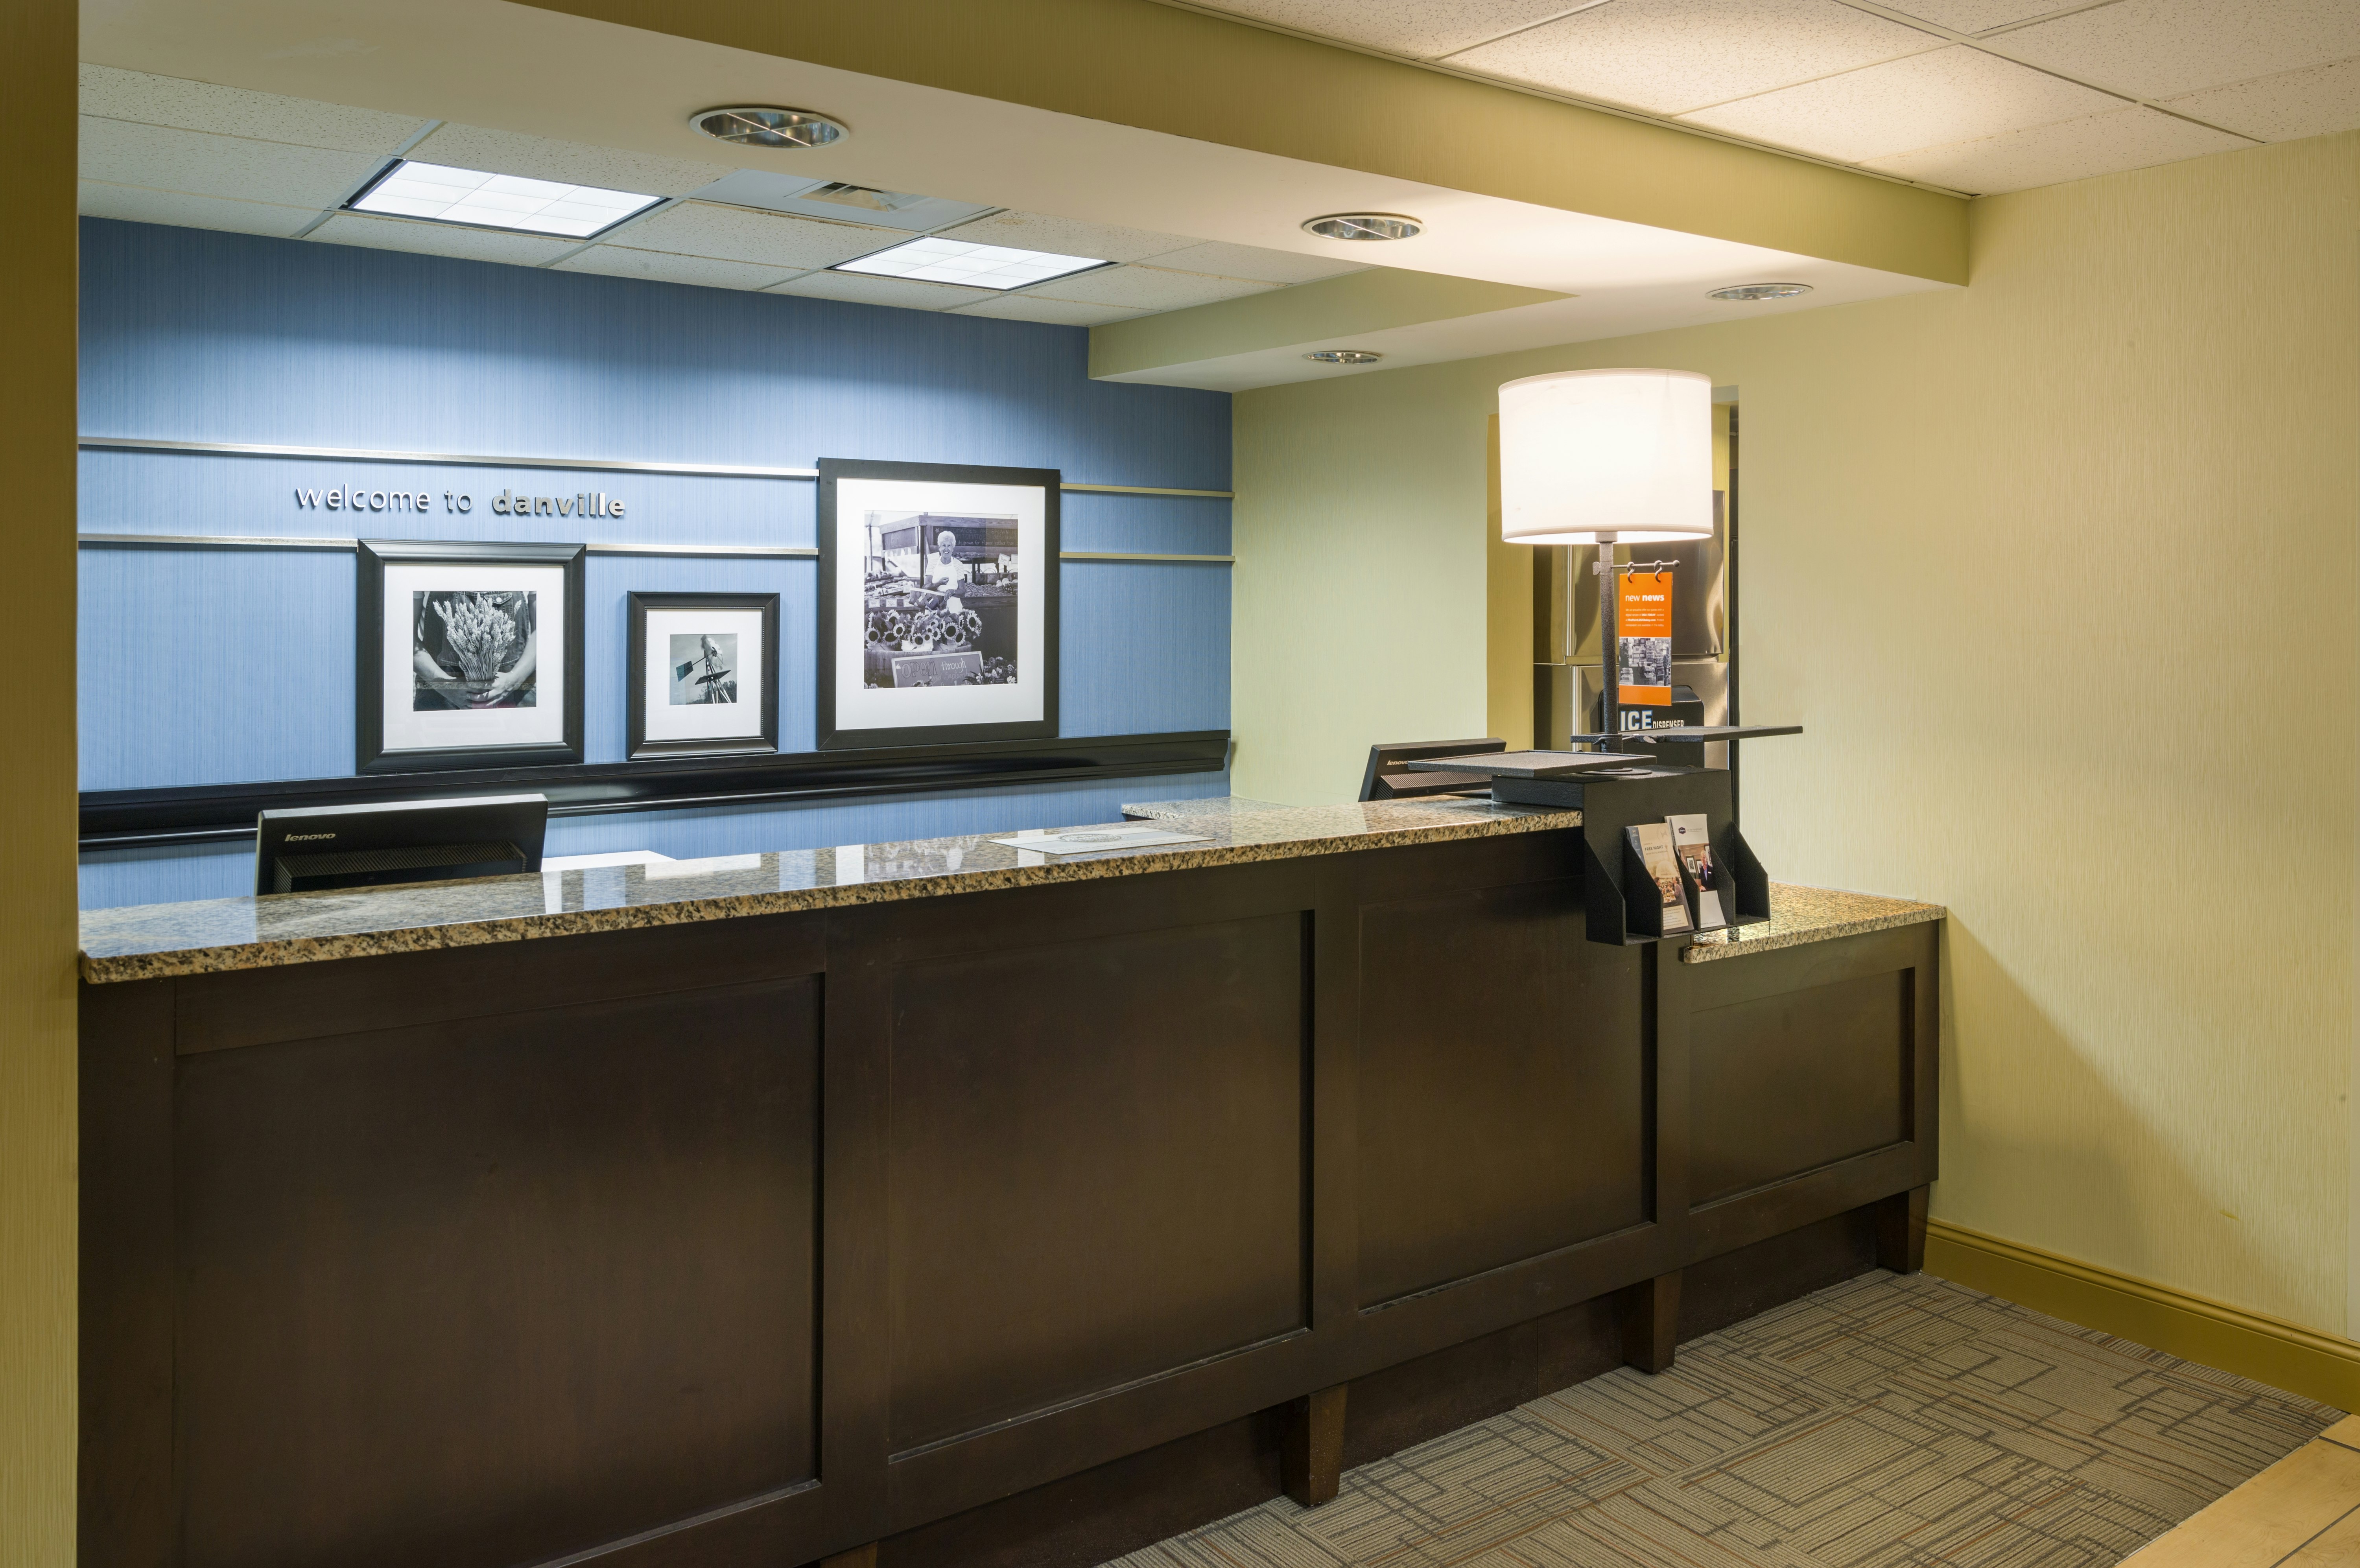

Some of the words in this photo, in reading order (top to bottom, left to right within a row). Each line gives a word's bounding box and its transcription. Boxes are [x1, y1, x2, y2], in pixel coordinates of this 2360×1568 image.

[296, 483, 430, 510] welcome
[444, 490, 472, 511] to
[492, 489, 626, 517] danville
[941, 658, 966, 673] through
[1620, 709, 1653, 731] ICE
[1653, 720, 1684, 728] DISPENSER
[285, 833, 336, 842] lenovo
